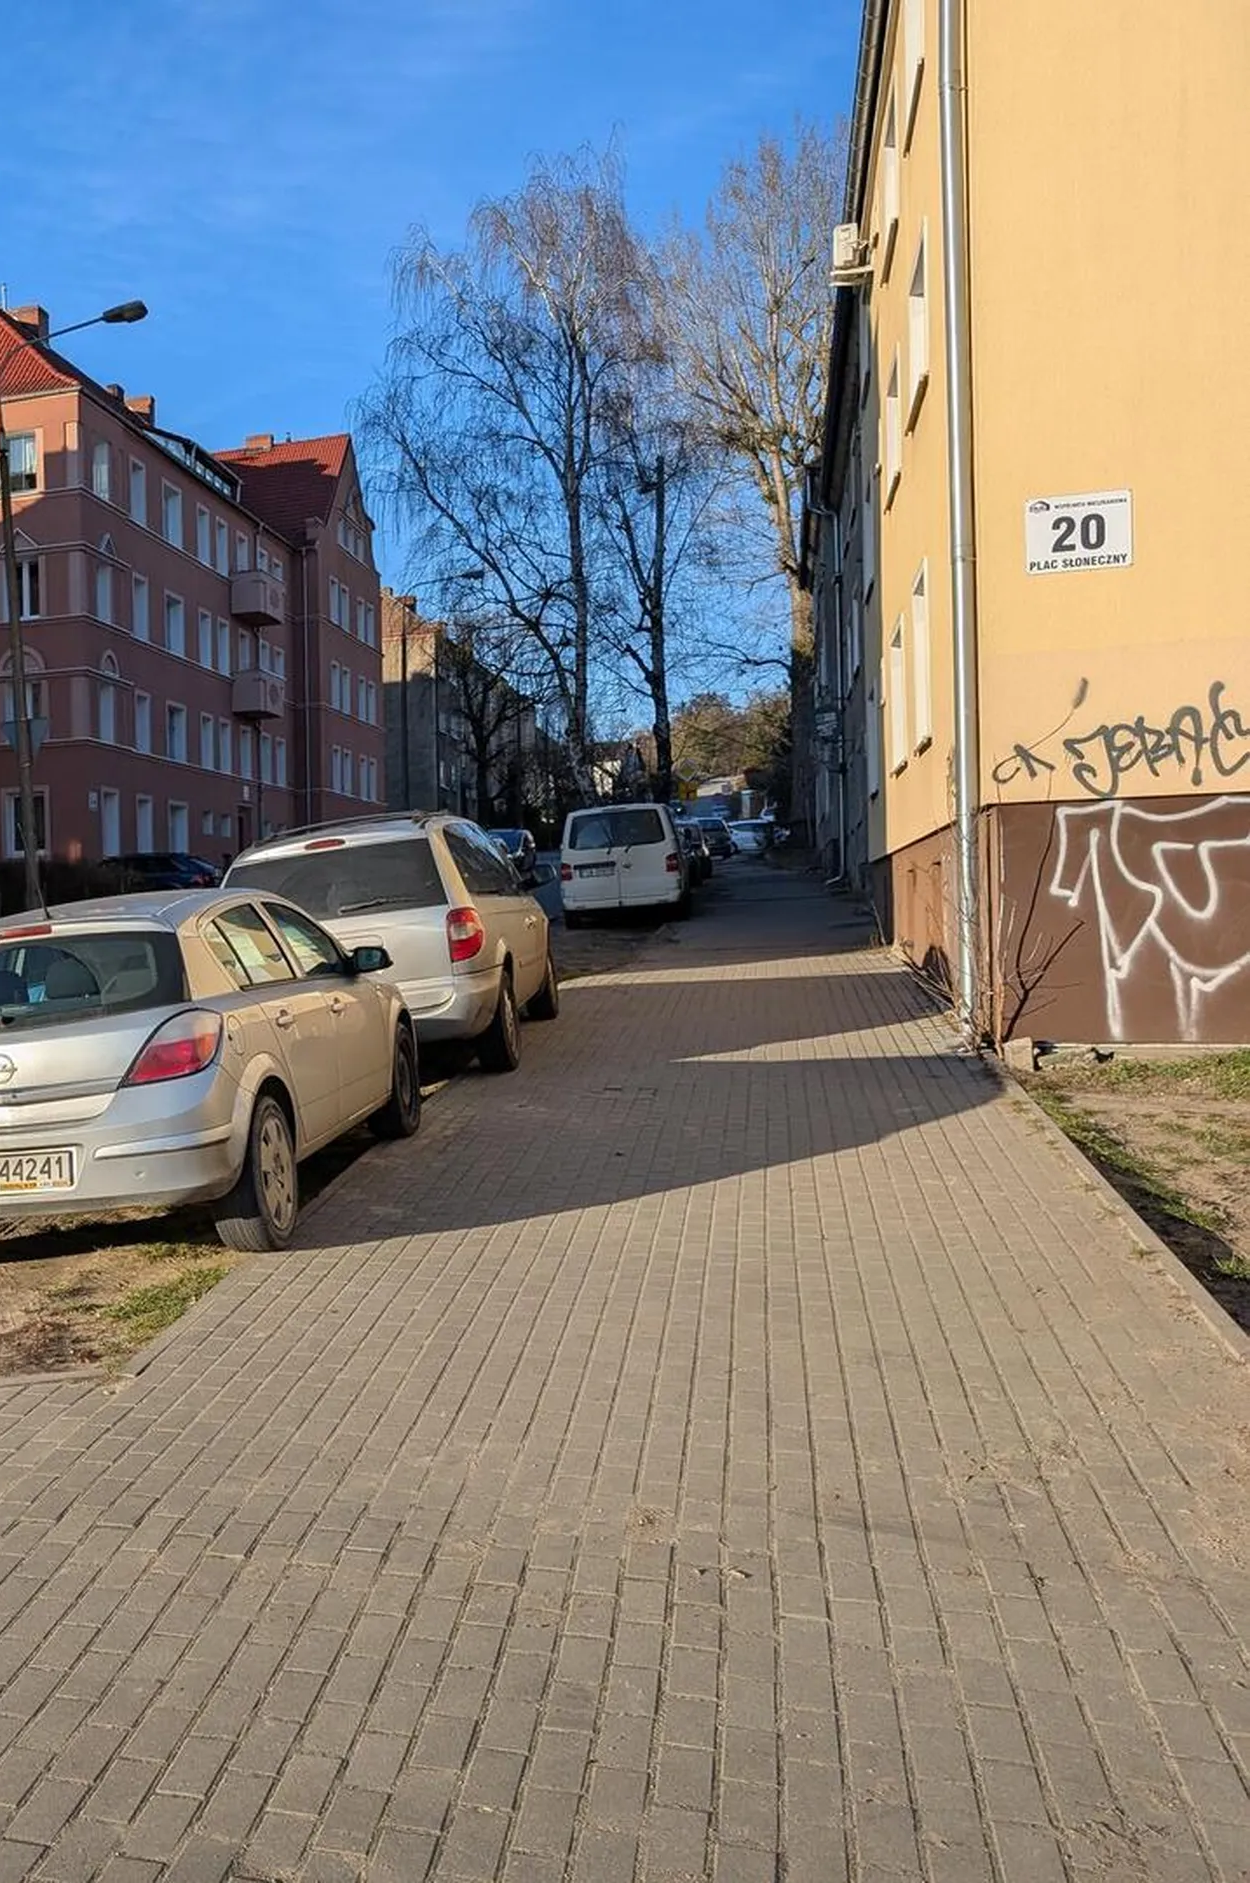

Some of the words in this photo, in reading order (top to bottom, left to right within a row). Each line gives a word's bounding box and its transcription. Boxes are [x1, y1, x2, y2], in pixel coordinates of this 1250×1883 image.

[1052, 513, 1105, 552] 20
[1030, 560, 1058, 571] PLAC
[1062, 554, 1127, 568] SŁONECZNY
